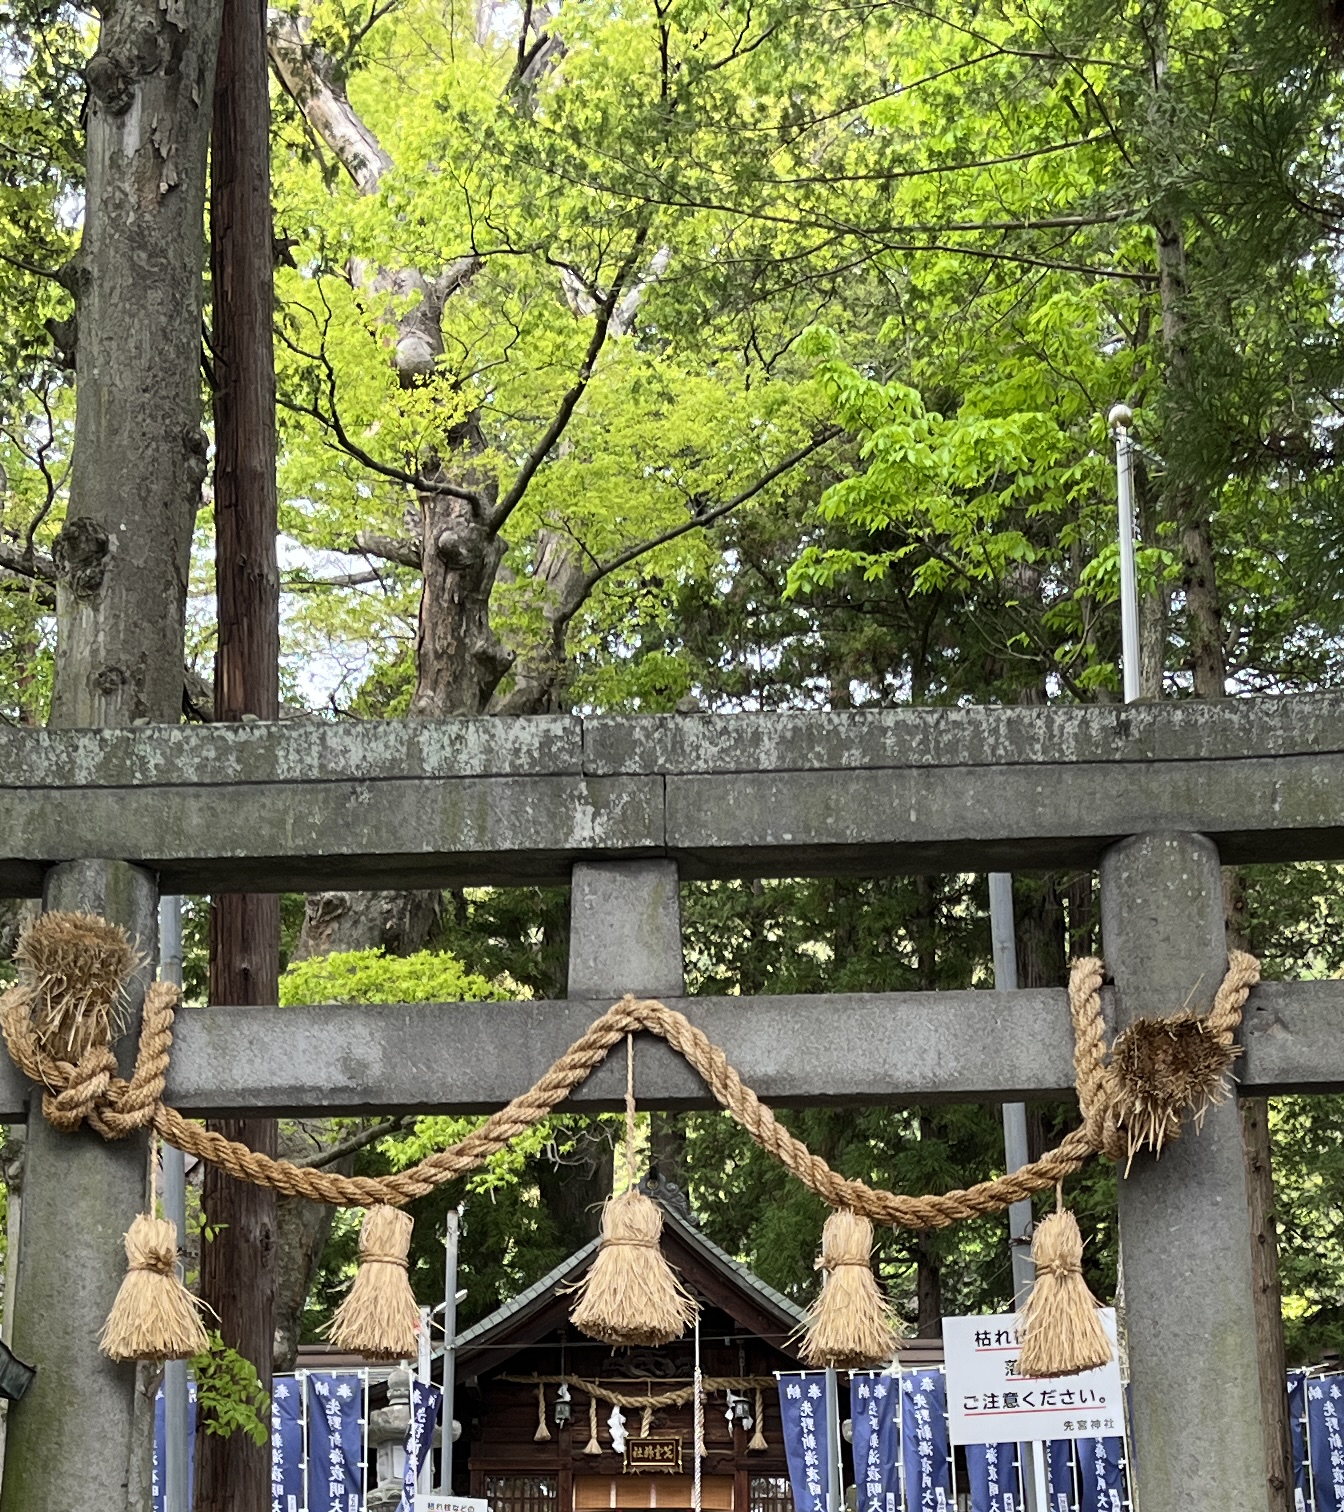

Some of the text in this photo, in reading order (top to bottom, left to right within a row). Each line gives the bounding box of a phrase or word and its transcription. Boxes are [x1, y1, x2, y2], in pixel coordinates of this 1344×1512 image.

[963, 1389, 1107, 1411] ご注意ください。
